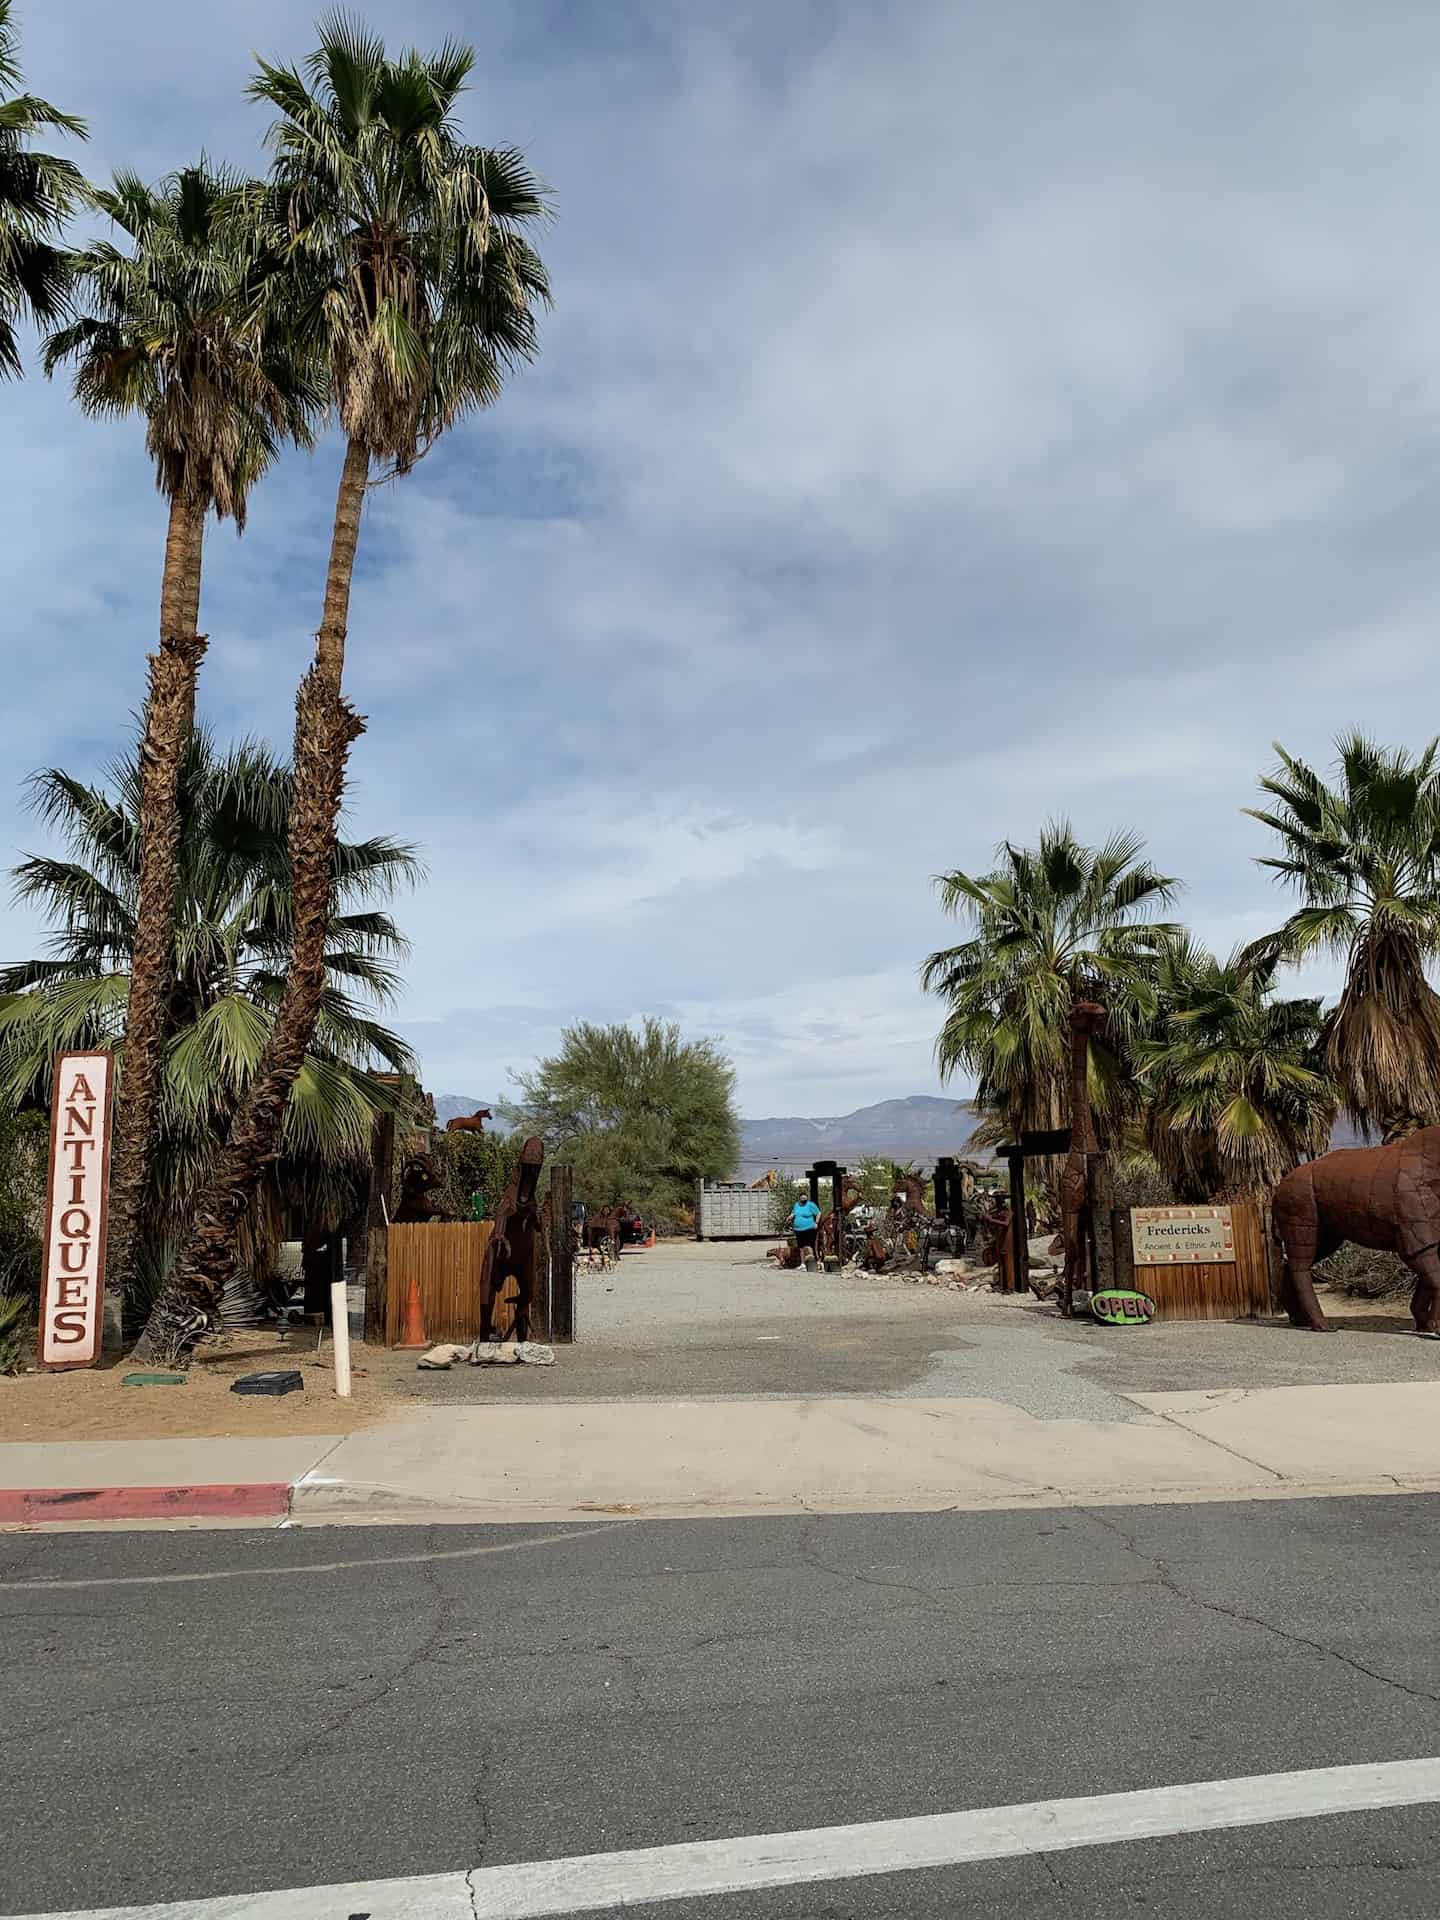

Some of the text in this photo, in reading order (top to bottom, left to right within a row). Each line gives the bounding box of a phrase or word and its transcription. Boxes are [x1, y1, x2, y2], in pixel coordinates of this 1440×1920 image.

[53, 1073, 97, 1344] ANTIQUES
[1147, 1223, 1211, 1236] Fredericks
[1144, 1239, 1222, 1250] Ancient & Ethnic Art
[1095, 1296, 1154, 1317] OPEN
